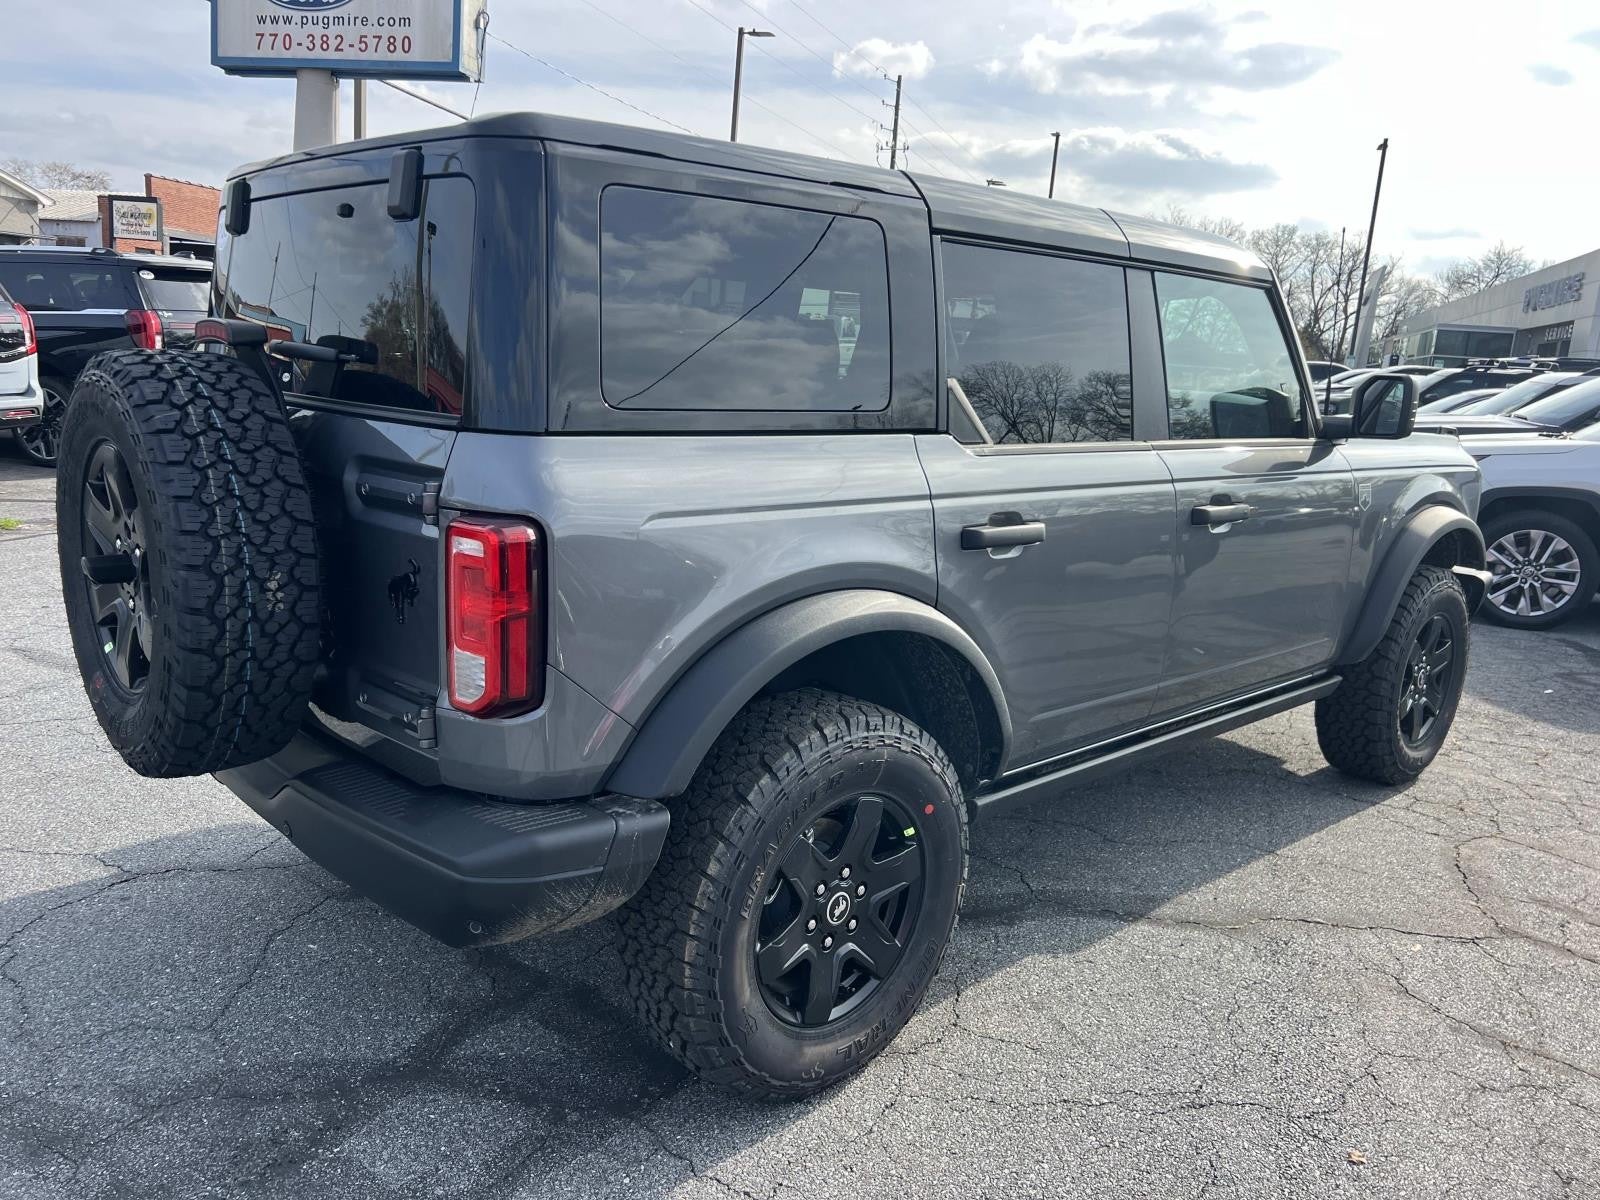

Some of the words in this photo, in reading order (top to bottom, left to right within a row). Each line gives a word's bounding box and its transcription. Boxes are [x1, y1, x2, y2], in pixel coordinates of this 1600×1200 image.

[256, 13, 412, 29] www.pugmire.com
[255, 33, 412, 53] 770-382-5780
[1545, 325, 1574, 341] SERVICE
